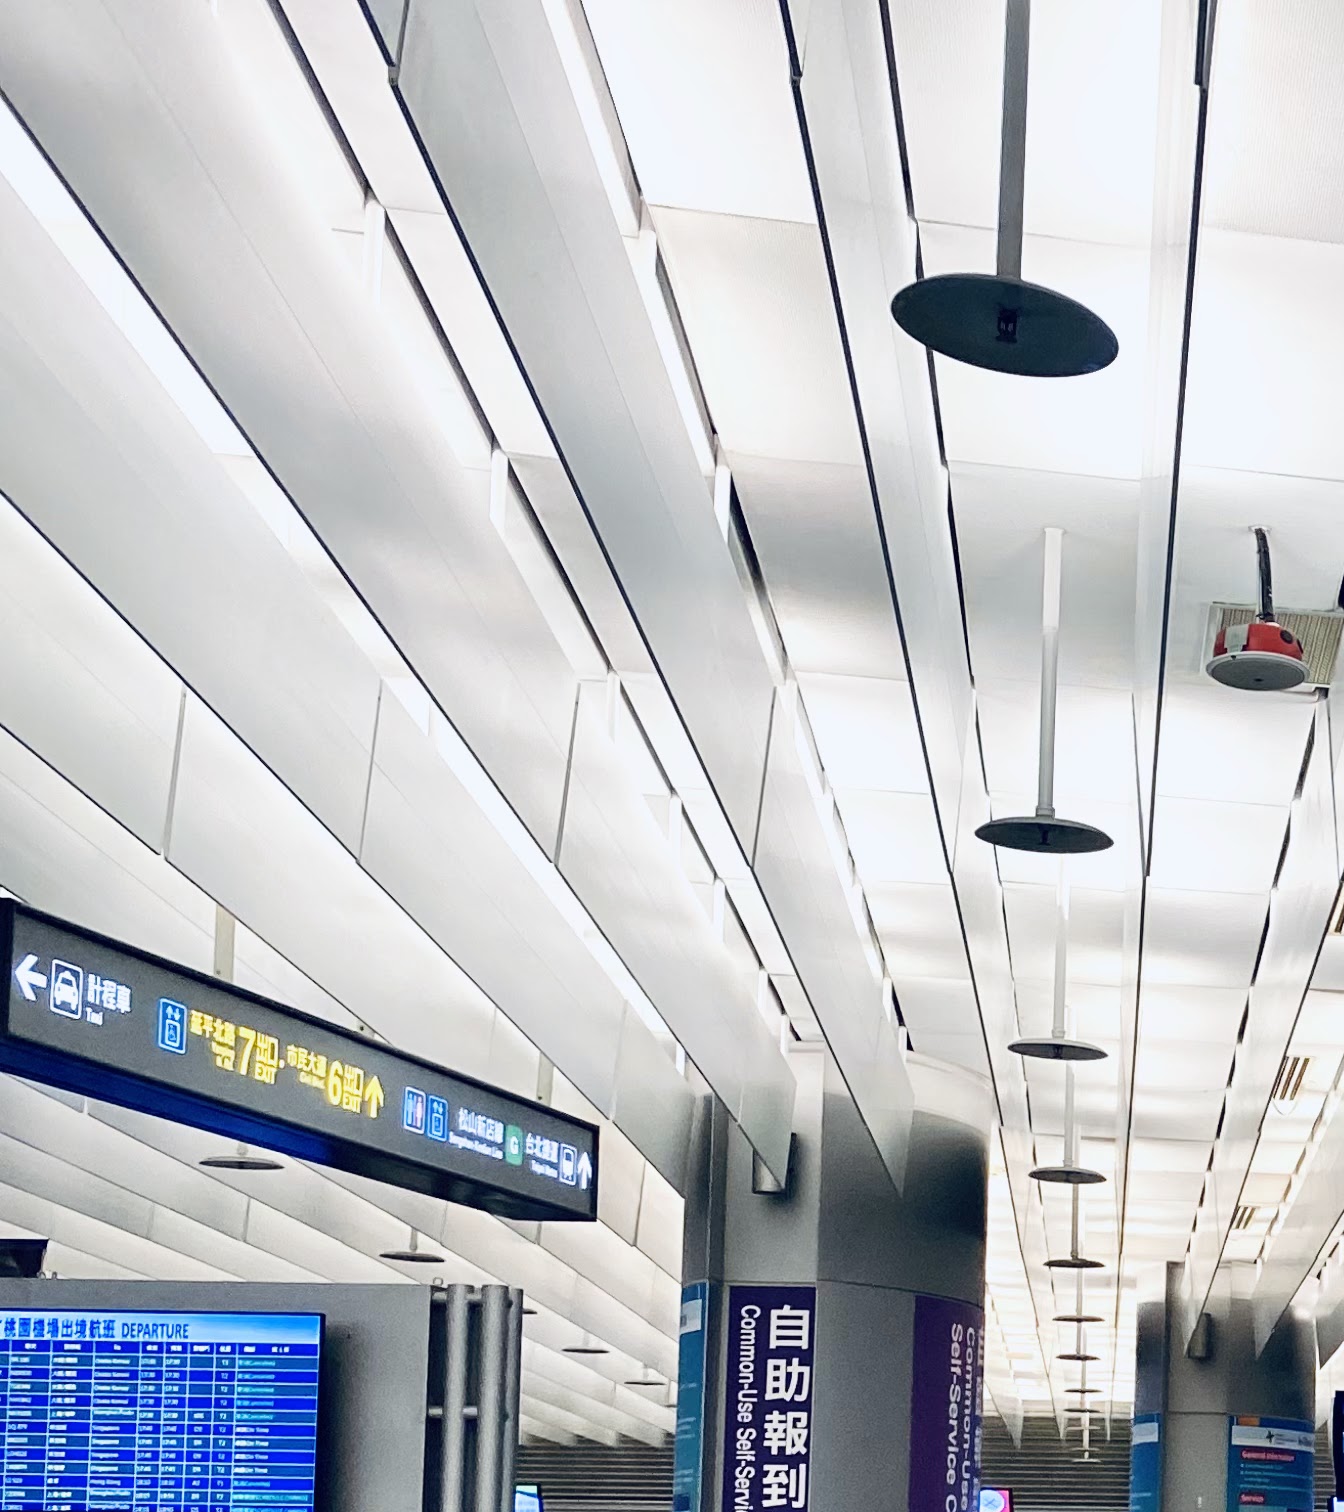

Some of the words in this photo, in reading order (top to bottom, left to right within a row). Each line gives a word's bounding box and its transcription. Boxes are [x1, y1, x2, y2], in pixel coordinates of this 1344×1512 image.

[87, 973, 132, 1014] 計程車
[236, 1026, 257, 1075] 7
[255, 1029, 279, 1068] 出口
[254, 1061, 277, 1085] EXIT
[327, 1060, 342, 1106] 6
[343, 1064, 365, 1097] 出口
[342, 1093, 362, 1114] EXIT
[509, 1135, 519, 1155] G
[0, 1318, 115, 1340] 桃園機場出境航班
[121, 1322, 190, 1339] DEPARTURE
[737, 1304, 761, 1423] Common-Use
[946, 1322, 964, 1486] Self-Service
[961, 1326, 976, 1511] Common-Use
